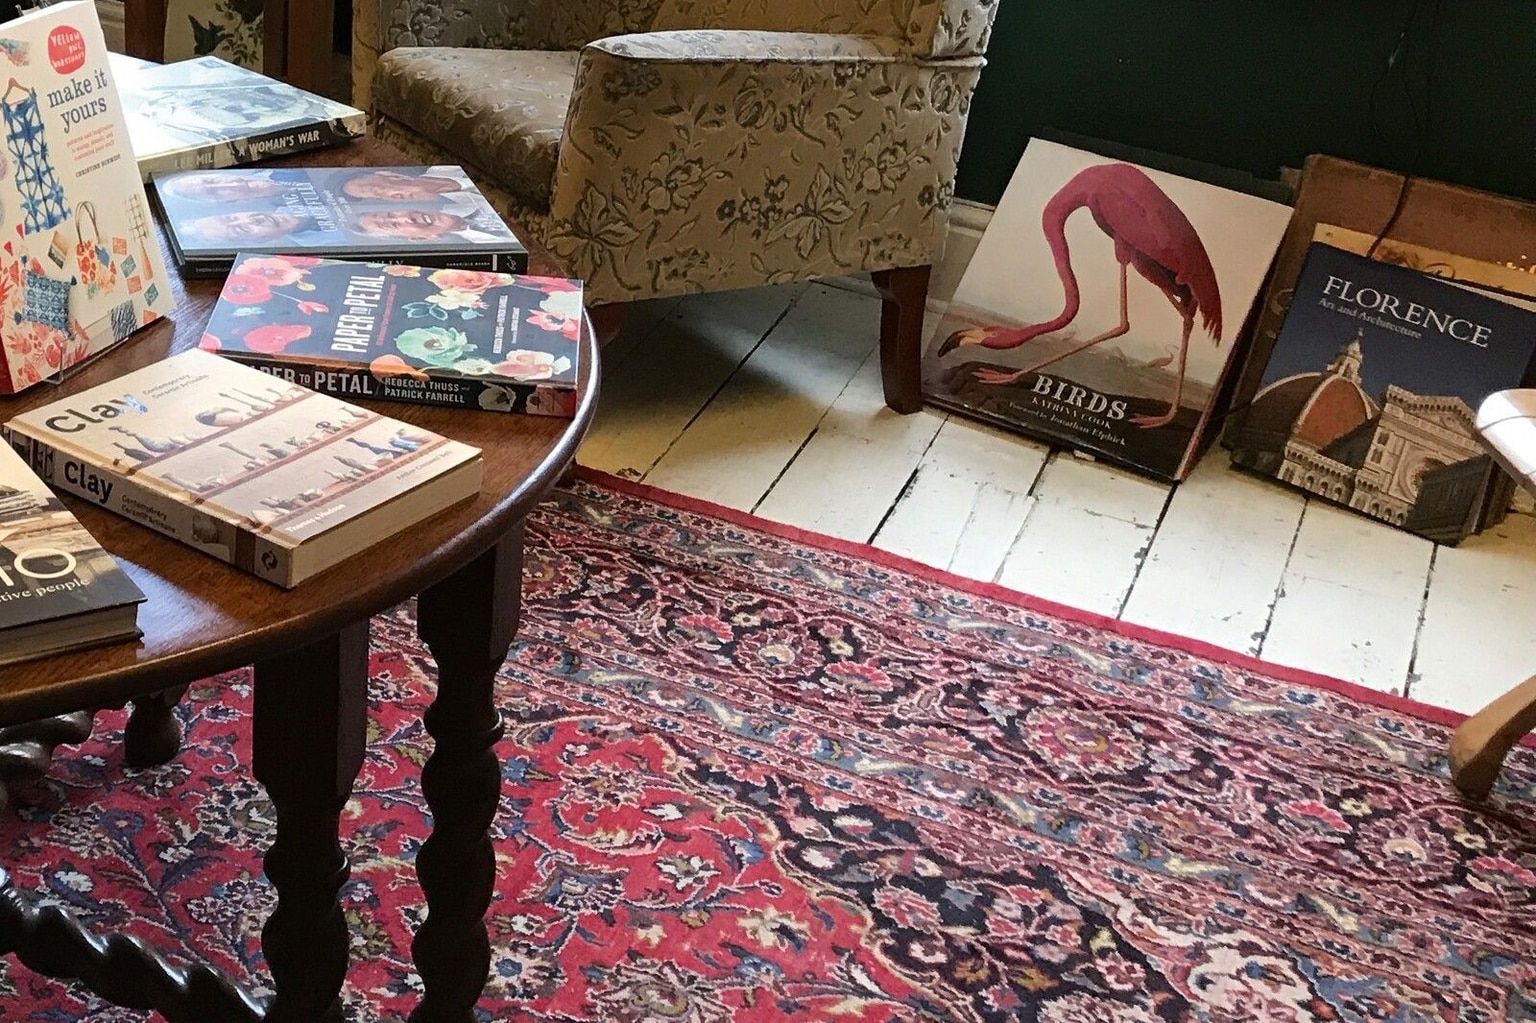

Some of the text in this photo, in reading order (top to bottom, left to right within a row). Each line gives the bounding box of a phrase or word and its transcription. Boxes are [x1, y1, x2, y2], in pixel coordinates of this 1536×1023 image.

[47, 69, 108, 108] make it
[61, 97, 107, 134] yours
[249, 135, 295, 154] WOMAN'S
[298, 130, 320, 144] WAR
[296, 181, 337, 233] GRACEFULLY
[344, 275, 386, 307] PETAL
[1319, 297, 1422, 339] Art and Architecture
[1323, 275, 1492, 348] FLORENCE
[331, 311, 369, 353] PAPER
[299, 373, 373, 395] TO PETAL
[385, 377, 427, 390] REBECCA
[429, 381, 460, 392] THUSS
[385, 388, 465, 404] PATRICK FARRELL
[1031, 375, 1127, 420] BIRDS
[47, 393, 148, 435] Clay
[1032, 396, 1111, 430] KATRINA COOK
[1050, 414, 1090, 434] Jonathan
[1092, 428, 1126, 446] Elphick
[65, 461, 168, 522] Clay Contemporary
[320, 502, 346, 520] Hudson
[35, 576, 91, 601] people
